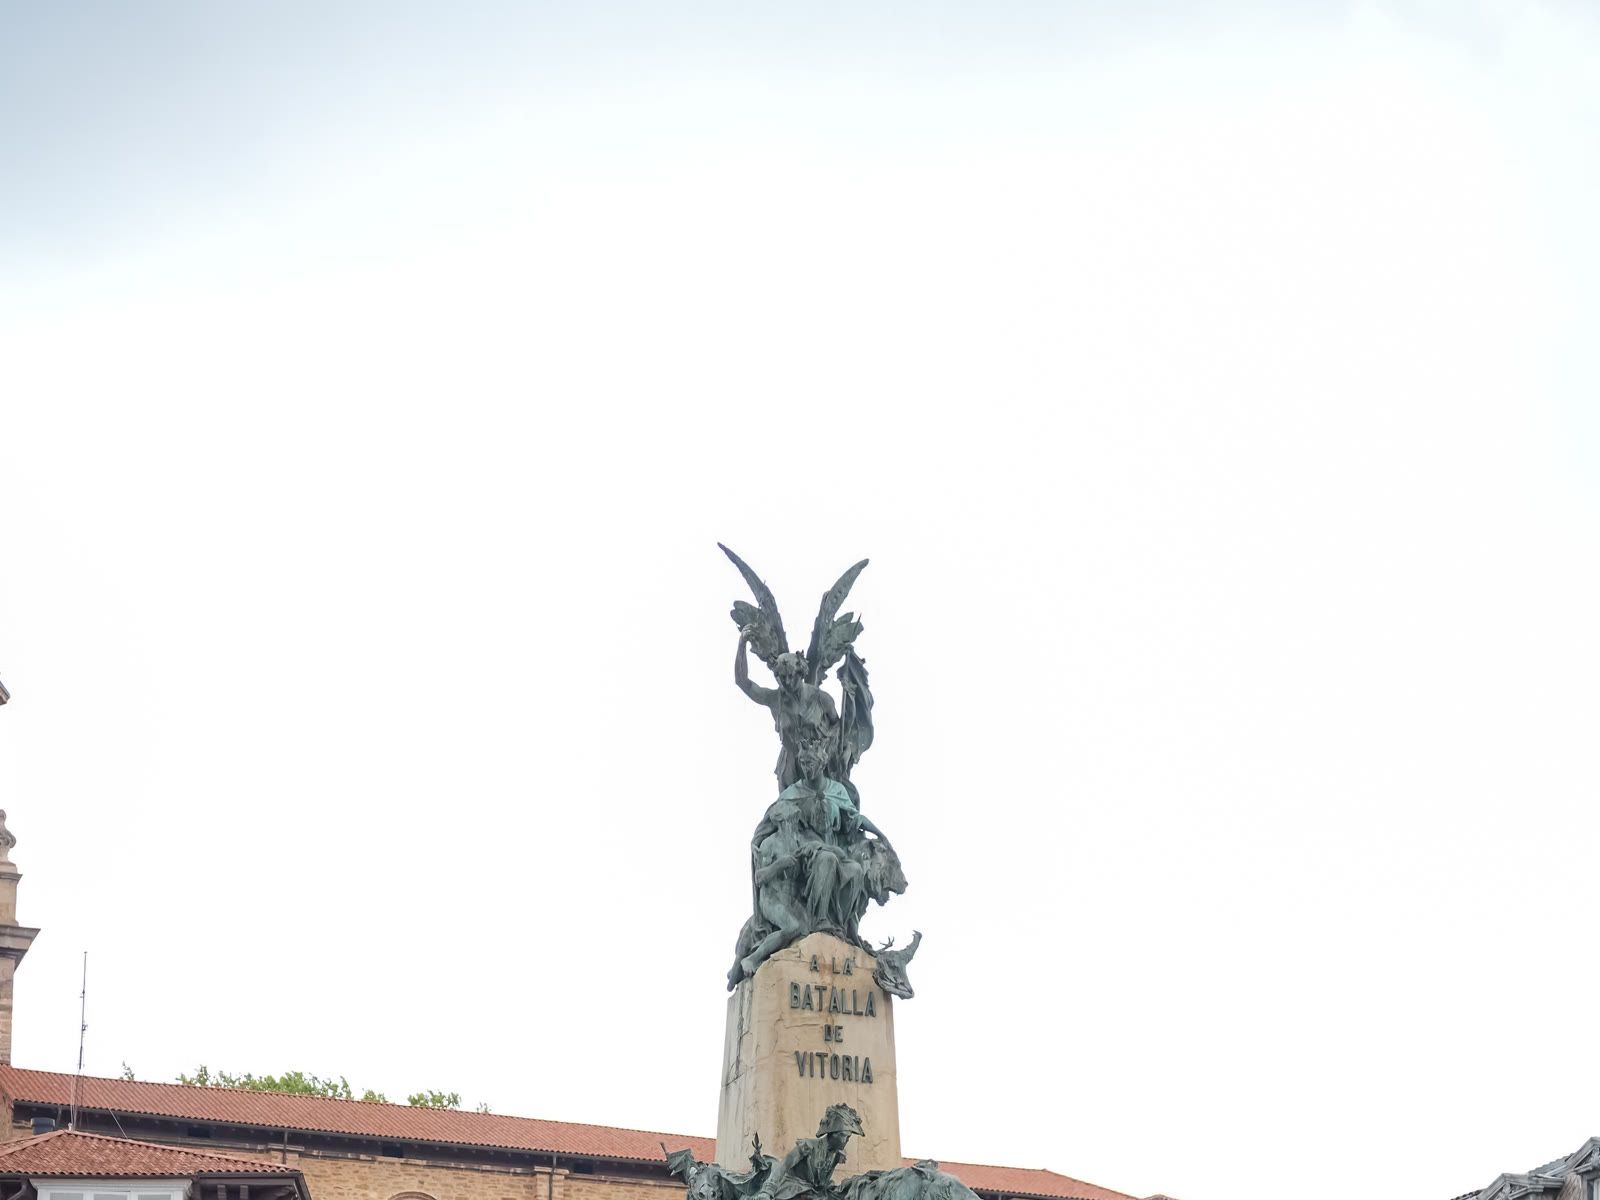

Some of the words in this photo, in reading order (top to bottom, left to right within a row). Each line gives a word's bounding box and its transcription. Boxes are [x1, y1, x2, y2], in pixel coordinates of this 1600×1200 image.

[810, 954, 819, 972] A
[832, 957, 853, 976] LA
[790, 982, 876, 1017] BATALLA
[824, 1024, 843, 1043] DE
[795, 1051, 873, 1084] VITORIA
